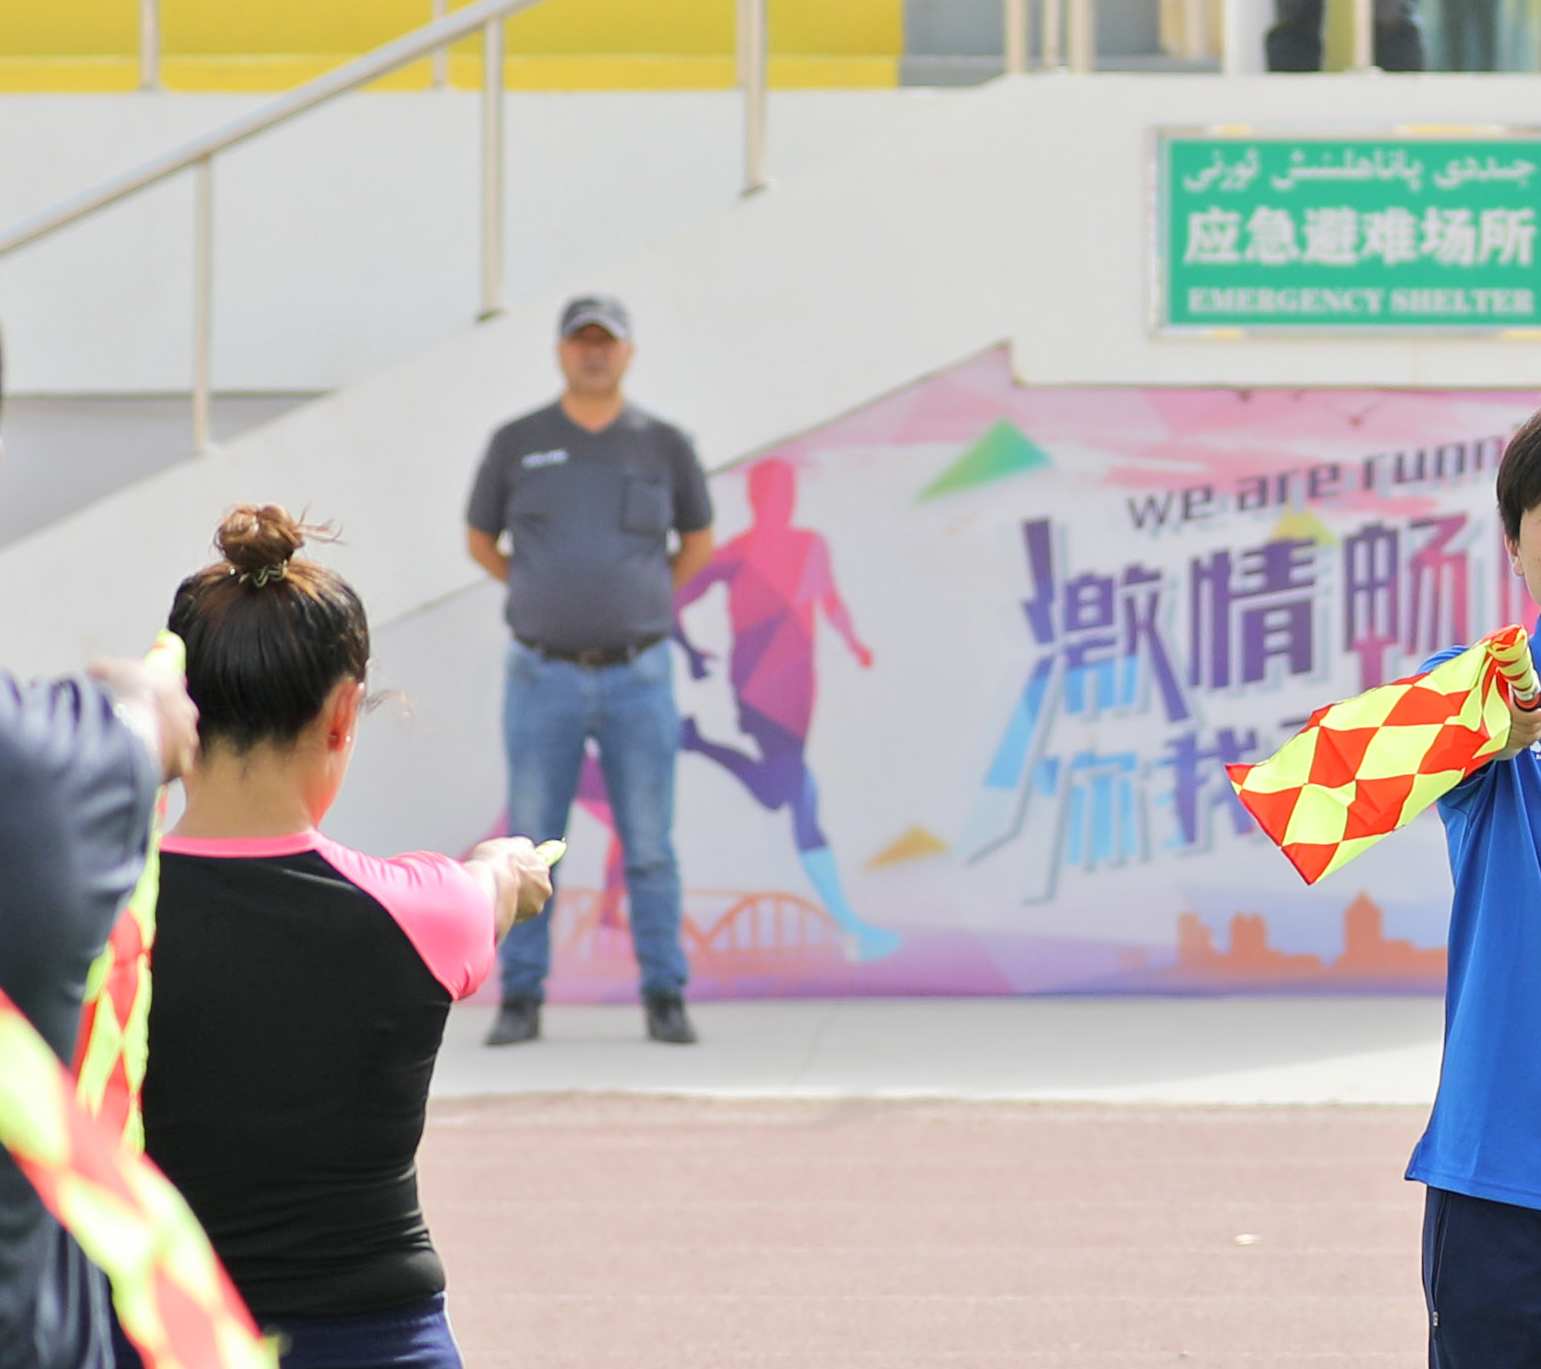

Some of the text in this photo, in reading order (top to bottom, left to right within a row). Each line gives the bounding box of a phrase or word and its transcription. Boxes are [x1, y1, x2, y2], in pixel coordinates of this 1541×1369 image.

[1183, 206, 1537, 266] 应急避难场所
[1188, 288, 1535, 314] EMERGENCY SHELTER
[1234, 462, 1341, 512] are
[1363, 434, 1506, 489] runn
